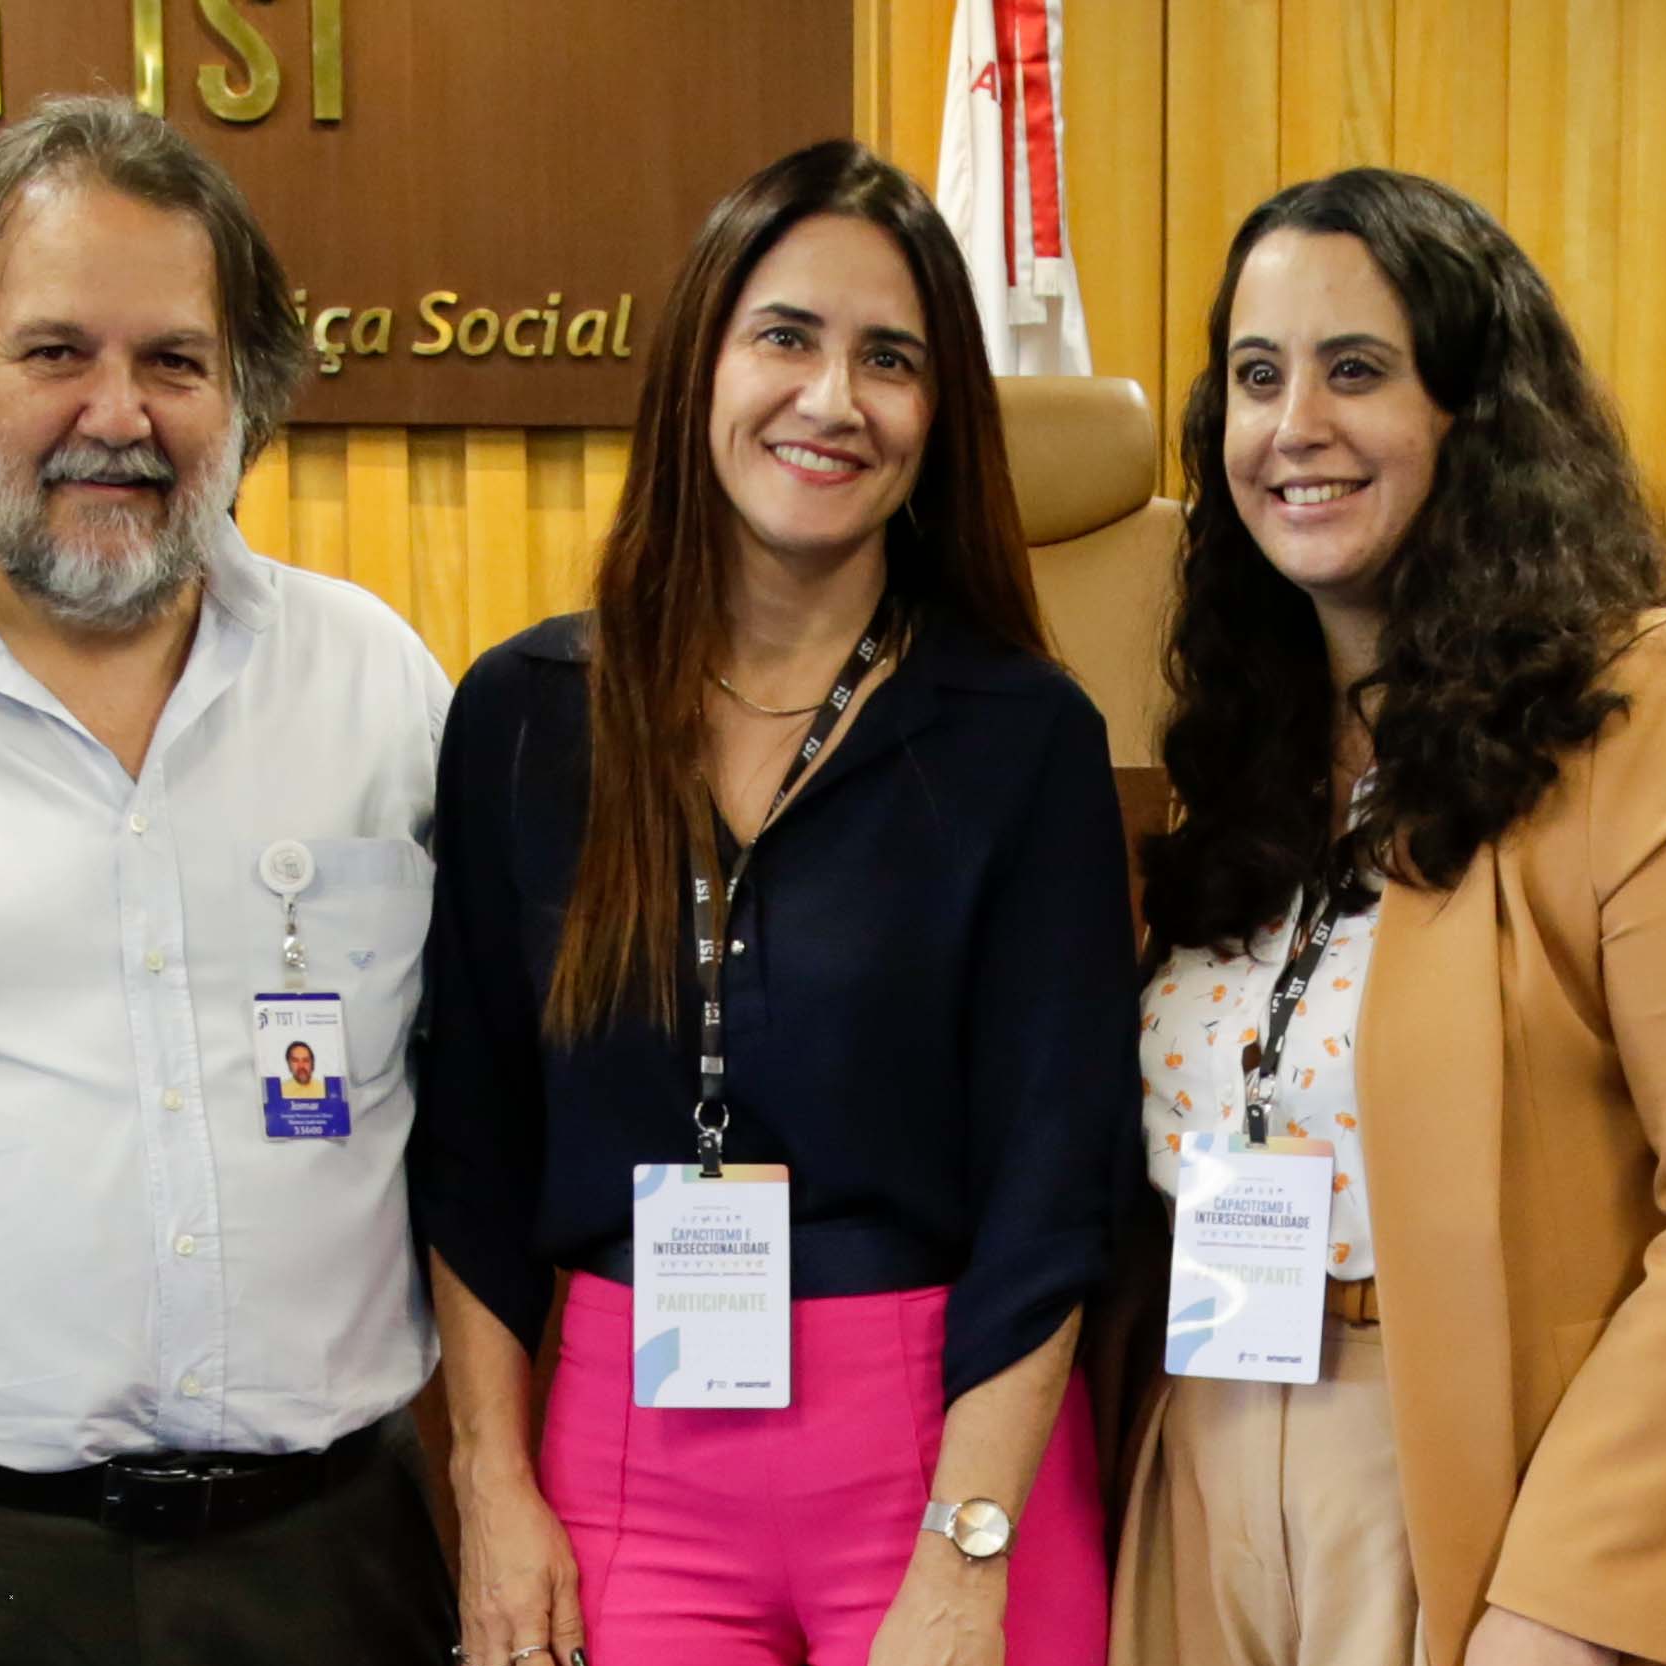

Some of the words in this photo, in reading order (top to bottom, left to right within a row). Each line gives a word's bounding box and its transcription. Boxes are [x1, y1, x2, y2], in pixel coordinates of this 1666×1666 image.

[411, 290, 632, 356] Social
[829, 684, 852, 711] TST
[802, 735, 822, 761] TST
[695, 877, 710, 904] TST
[1310, 920, 1332, 947] TST
[699, 938, 714, 964] TST
[1284, 975, 1307, 1000] TST
[656, 1293, 768, 1313] PARTICIPANTE
